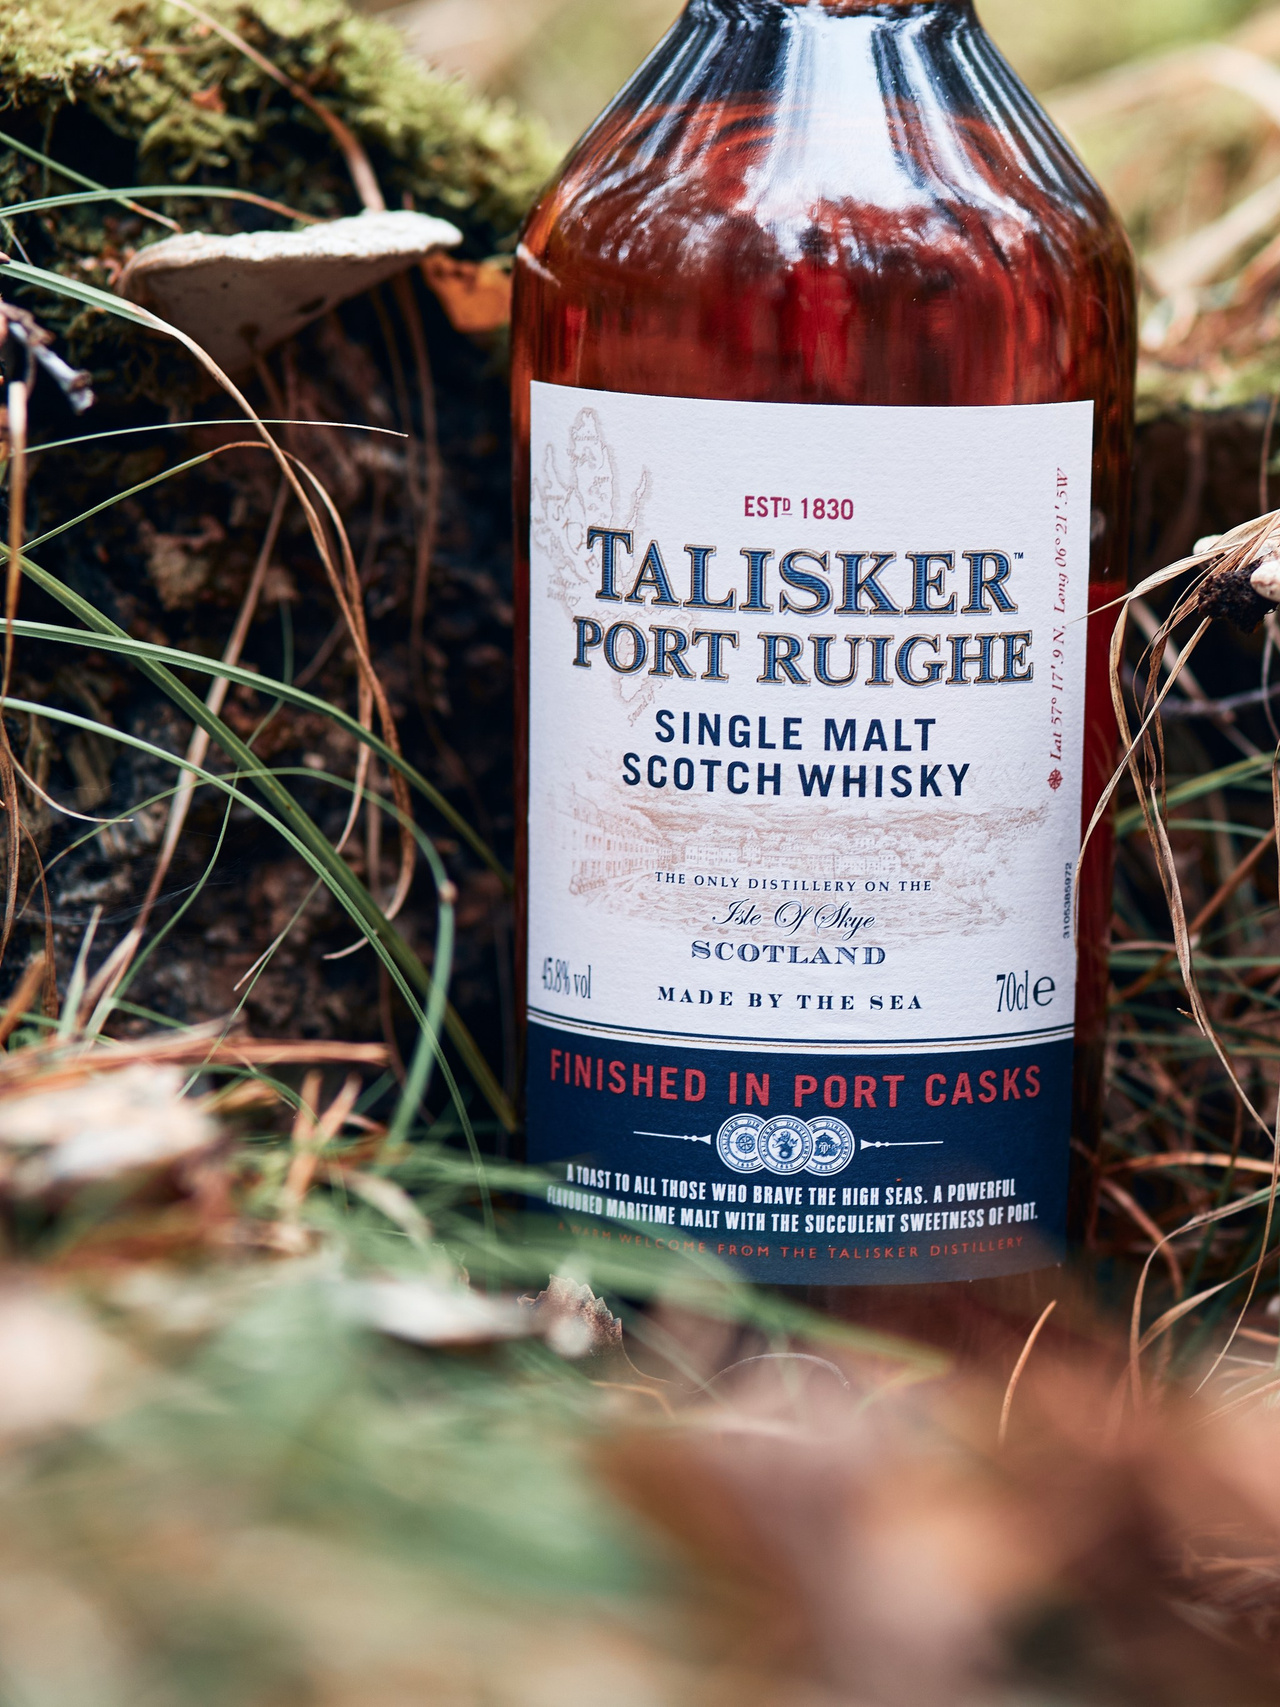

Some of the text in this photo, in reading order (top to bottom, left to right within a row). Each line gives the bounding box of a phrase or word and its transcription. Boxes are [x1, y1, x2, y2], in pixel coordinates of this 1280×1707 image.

[801, 497, 854, 520] 1830
[586, 526, 1018, 618] TALISKER
[1054, 572, 1069, 613] Long
[572, 616, 1035, 687] PORT RUIGHE
[655, 709, 936, 752] SINGLE MALT
[1050, 732, 1062, 761] Lat
[622, 753, 971, 798] SCOTCH WHISKY
[655, 871, 932, 892] THE ONLY DISTILLERY ON THE
[712, 898, 875, 940] Isle Of Skye
[691, 940, 886, 965] SCOTLAND
[574, 965, 591, 999] vol
[658, 985, 923, 1010] MADE BY THE SEA
[996, 970, 1029, 1012] 70cl
[551, 1049, 1041, 1109] FINISHED IN PORT CASKS
[566, 1164, 1016, 1206] A TOAST TO ALL THOSE WHO BRAVE THE HIGH SEAS. A POWERFUL
[547, 1185, 1038, 1233] FLAVOURED MARITIME MALT WITH THE SUCCULENT SWEETNESS OF PORT.
[618, 1233, 706, 1254] WELCOME
[718, 1244, 769, 1258] FROM
[781, 1246, 817, 1259] THE
[828, 1246, 919, 1260] TALISKER
[930, 1236, 1023, 1257] DISTILLERY
